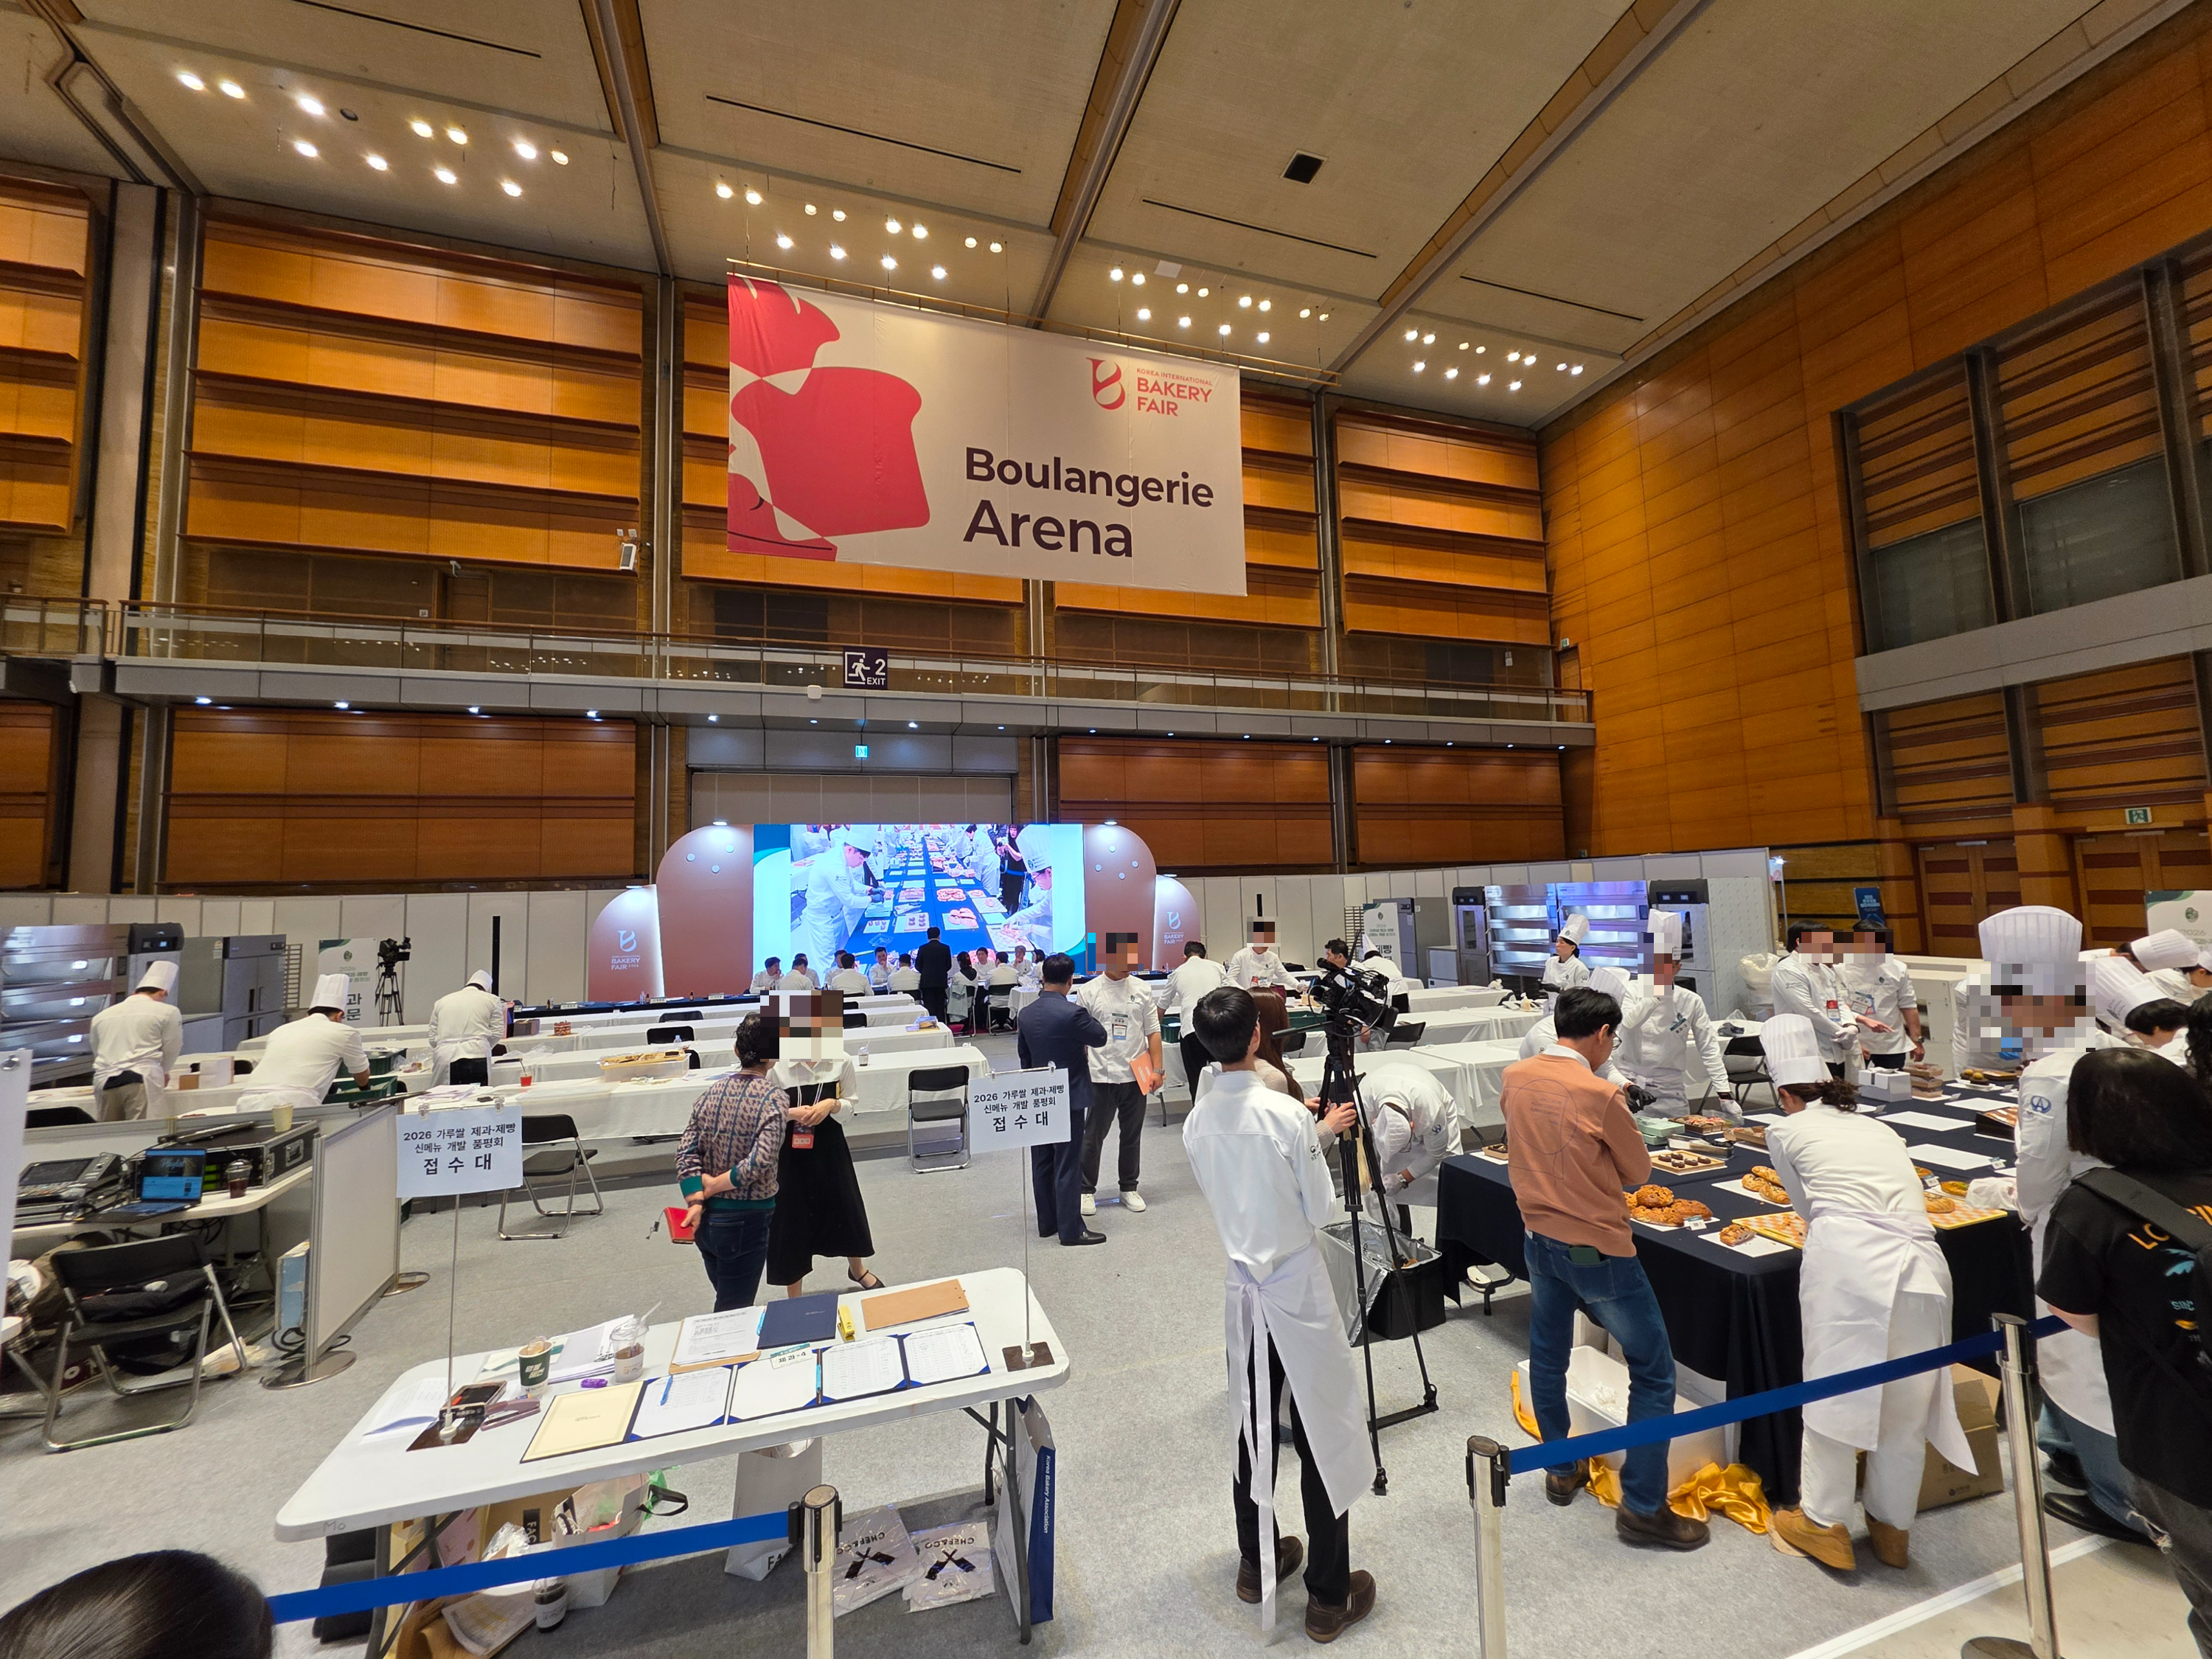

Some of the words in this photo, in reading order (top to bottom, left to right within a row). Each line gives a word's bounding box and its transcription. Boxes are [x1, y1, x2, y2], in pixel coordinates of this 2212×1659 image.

[1136, 367, 1160, 378] KOREA
[1161, 372, 1213, 386] INTERNATIONAL
[1137, 377, 1212, 403] BAKERY
[1137, 396, 1178, 417] FAIR
[964, 446, 1214, 508] Boulangerie
[963, 499, 1133, 558] Arena
[875, 658, 886, 675] 2
[866, 677, 886, 686] EXIT
[347, 993, 362, 1006] 과
[974, 1093, 998, 1103] 2026
[1003, 1089, 1026, 1100] 가루쌀
[1031, 1085, 1064, 1096] 제과·제빵
[984, 1104, 1008, 1114] 신메뉴
[1012, 1100, 1029, 1110] 개발
[1033, 1096, 1056, 1108] 품평회
[403, 1131, 432, 1141] 2026
[437, 1127, 465, 1140] 가루쌀
[470, 1123, 516, 1136] 제과·제빵
[414, 1143, 442, 1154] 신메뉴
[447, 1141, 467, 1152] 개발
[472, 1136, 504, 1150] 품평회
[836, 1531, 885, 1554] CHEF&CO
[925, 1537, 975, 1549] CHEF&CO
